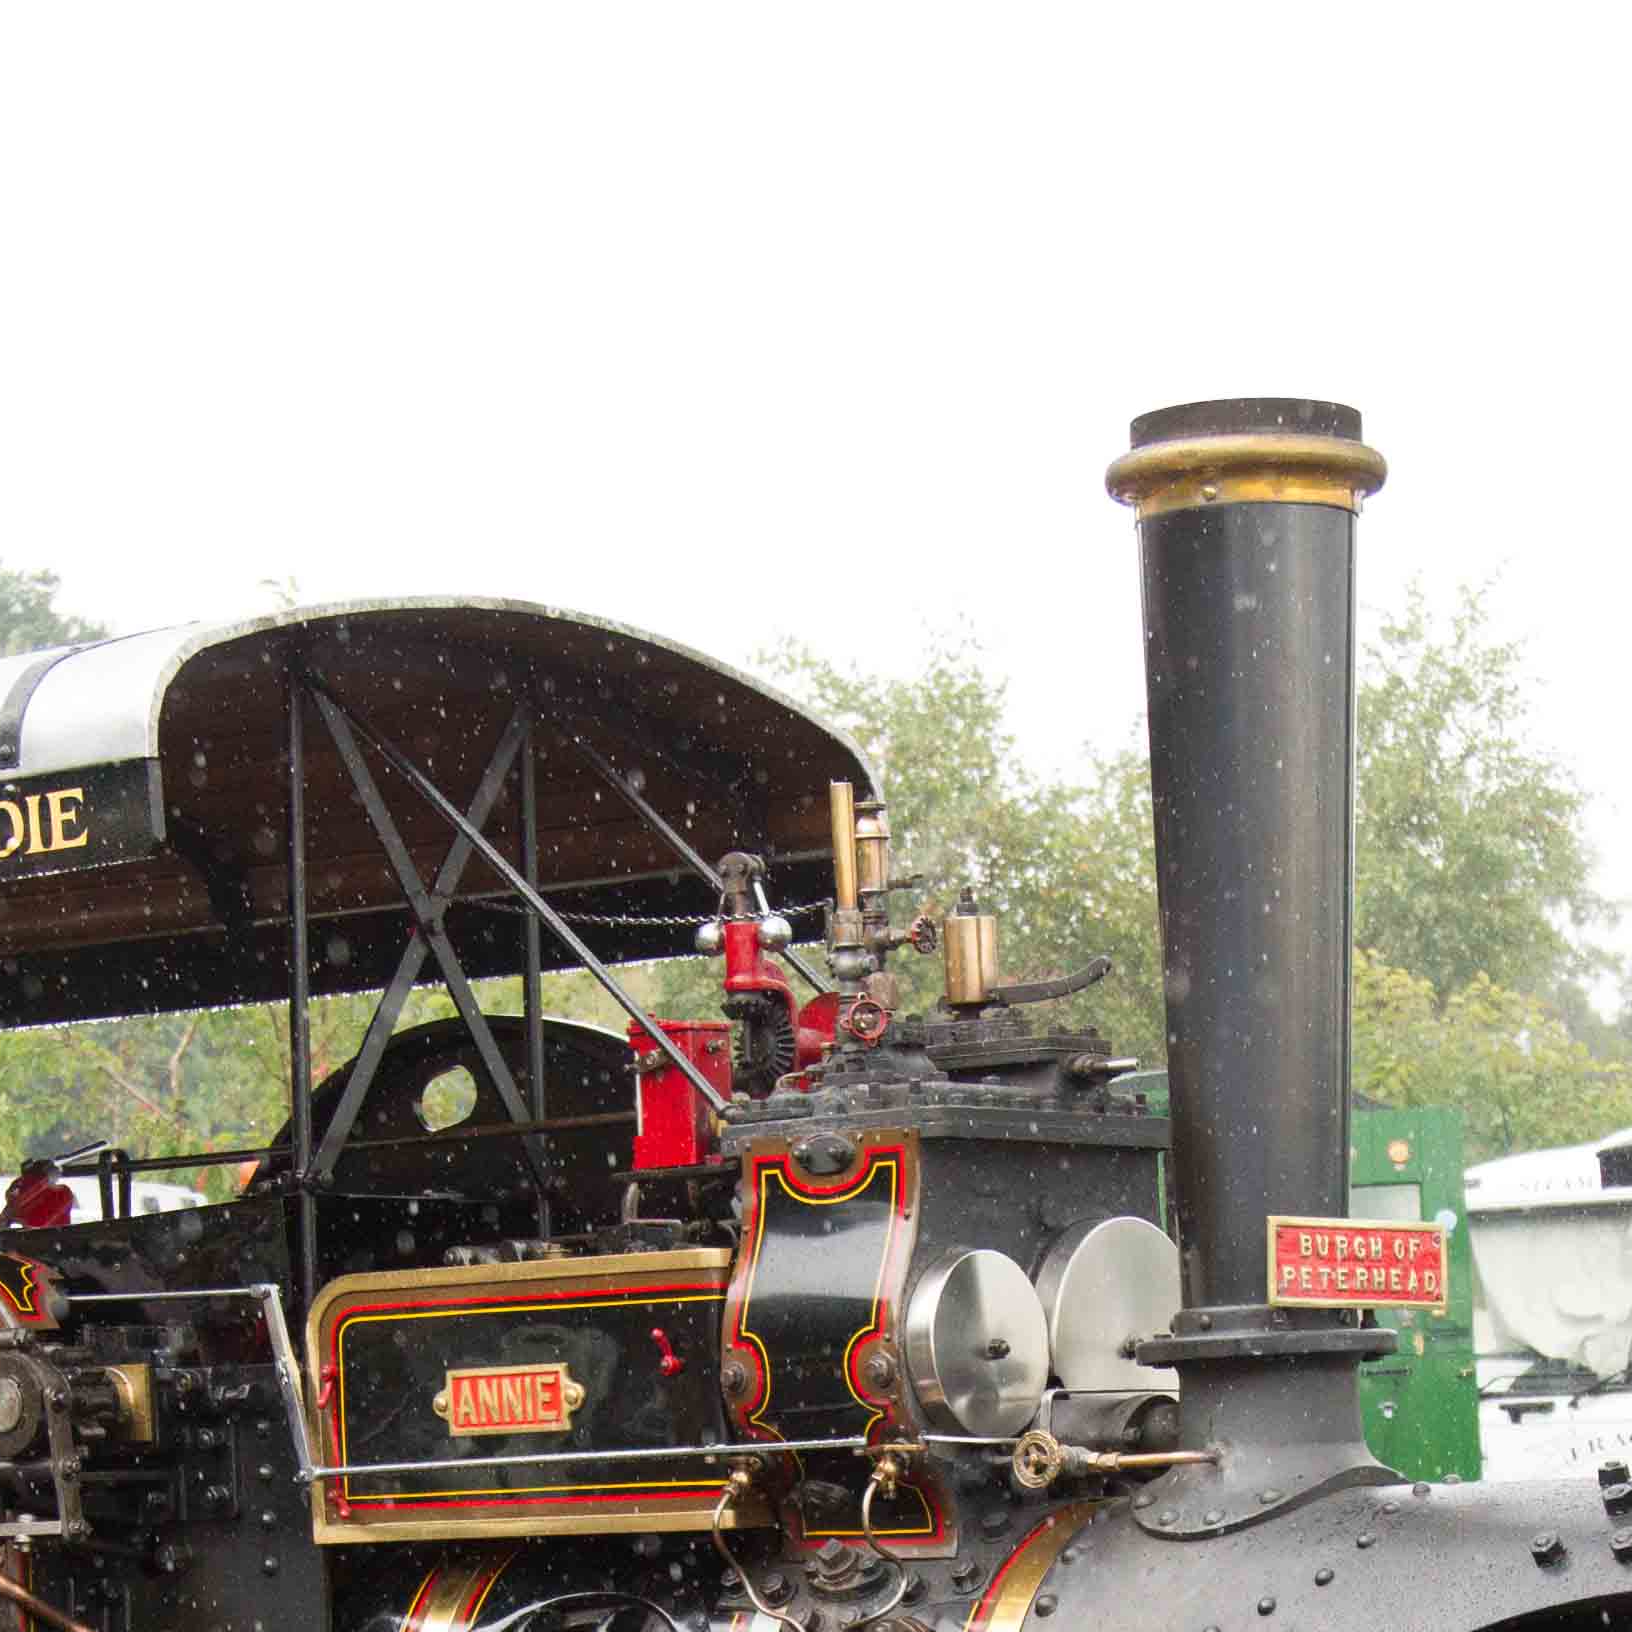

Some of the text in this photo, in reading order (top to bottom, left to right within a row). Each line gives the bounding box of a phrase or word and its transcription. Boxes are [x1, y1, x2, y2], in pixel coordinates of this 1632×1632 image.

[1299, 1231, 1422, 1261] BURGH OF
[1280, 1264, 1437, 1293] PETERHEAD
[457, 1374, 558, 1426] ANNIE
